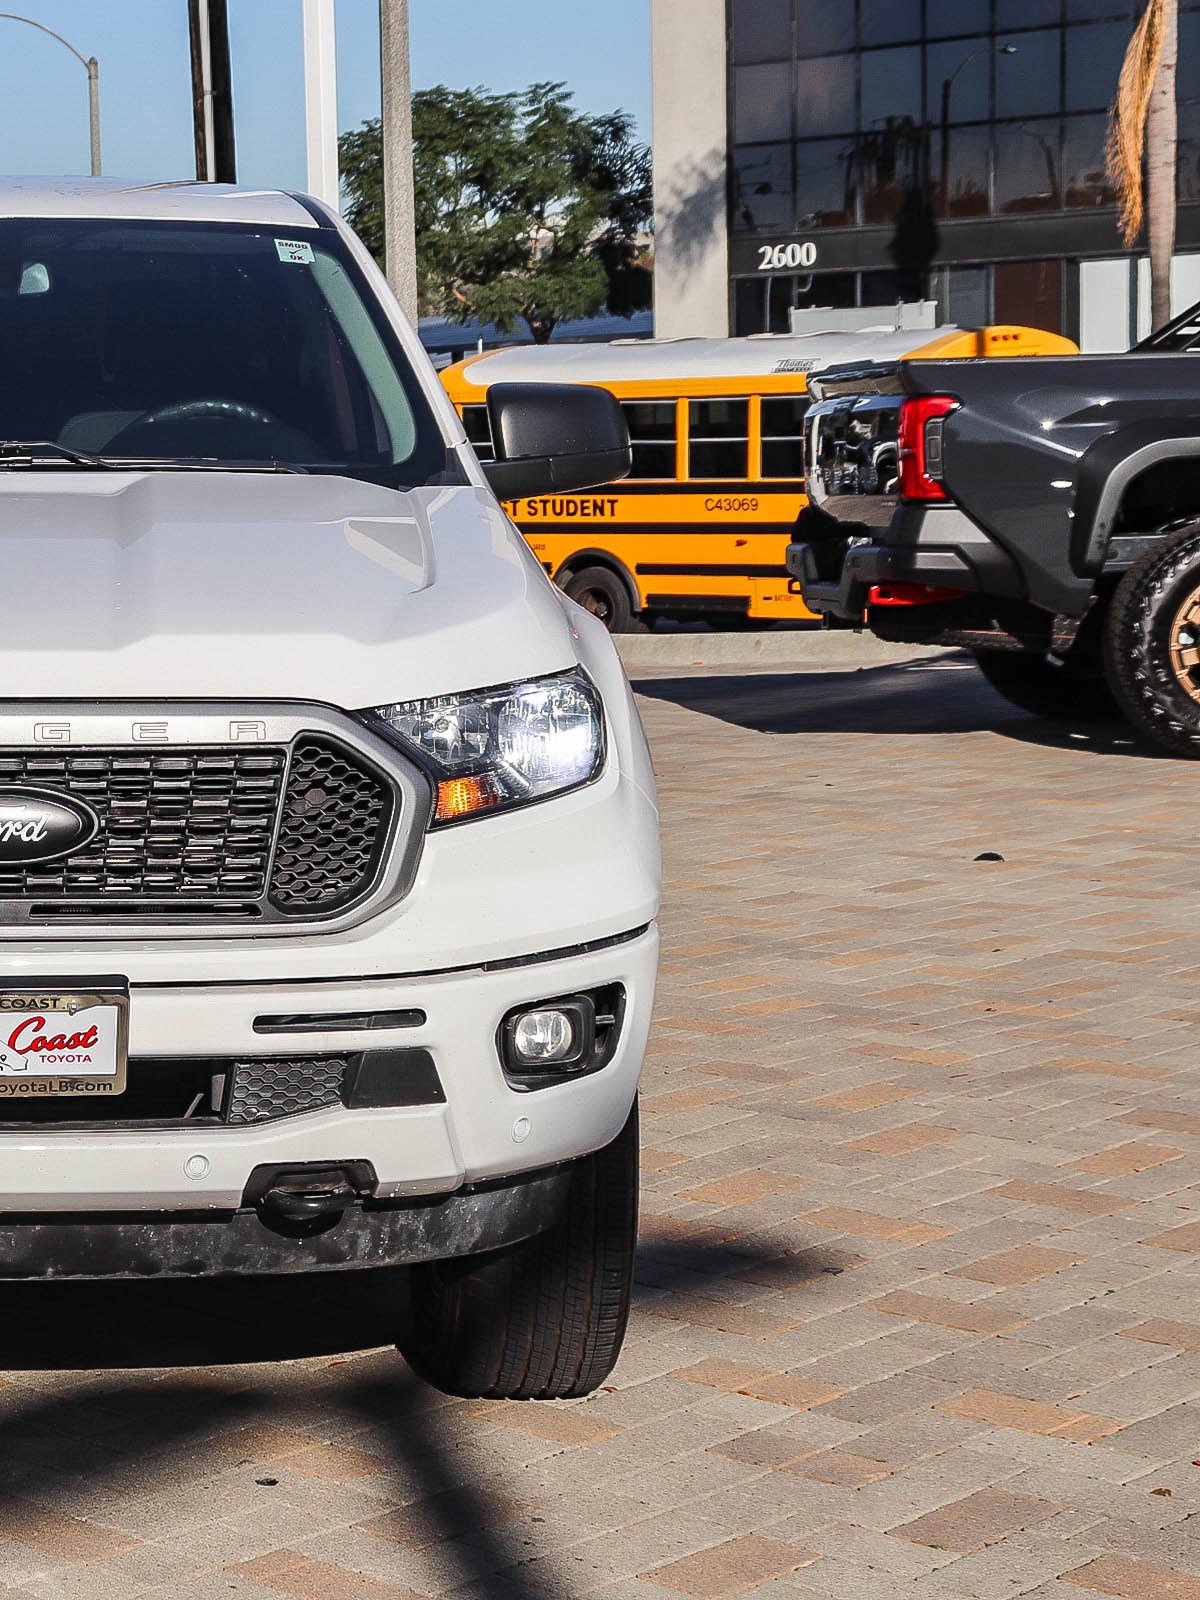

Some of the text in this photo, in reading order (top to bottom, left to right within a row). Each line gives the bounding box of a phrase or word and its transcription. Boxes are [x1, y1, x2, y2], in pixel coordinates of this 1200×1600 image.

[757, 242, 817, 270] 2600
[527, 499, 619, 517] STUDENT
[704, 498, 759, 512] C43069
[0, 998, 60, 1010] COAST
[7, 1016, 98, 1055] Coast
[40, 1054, 92, 1064] TOYOTA
